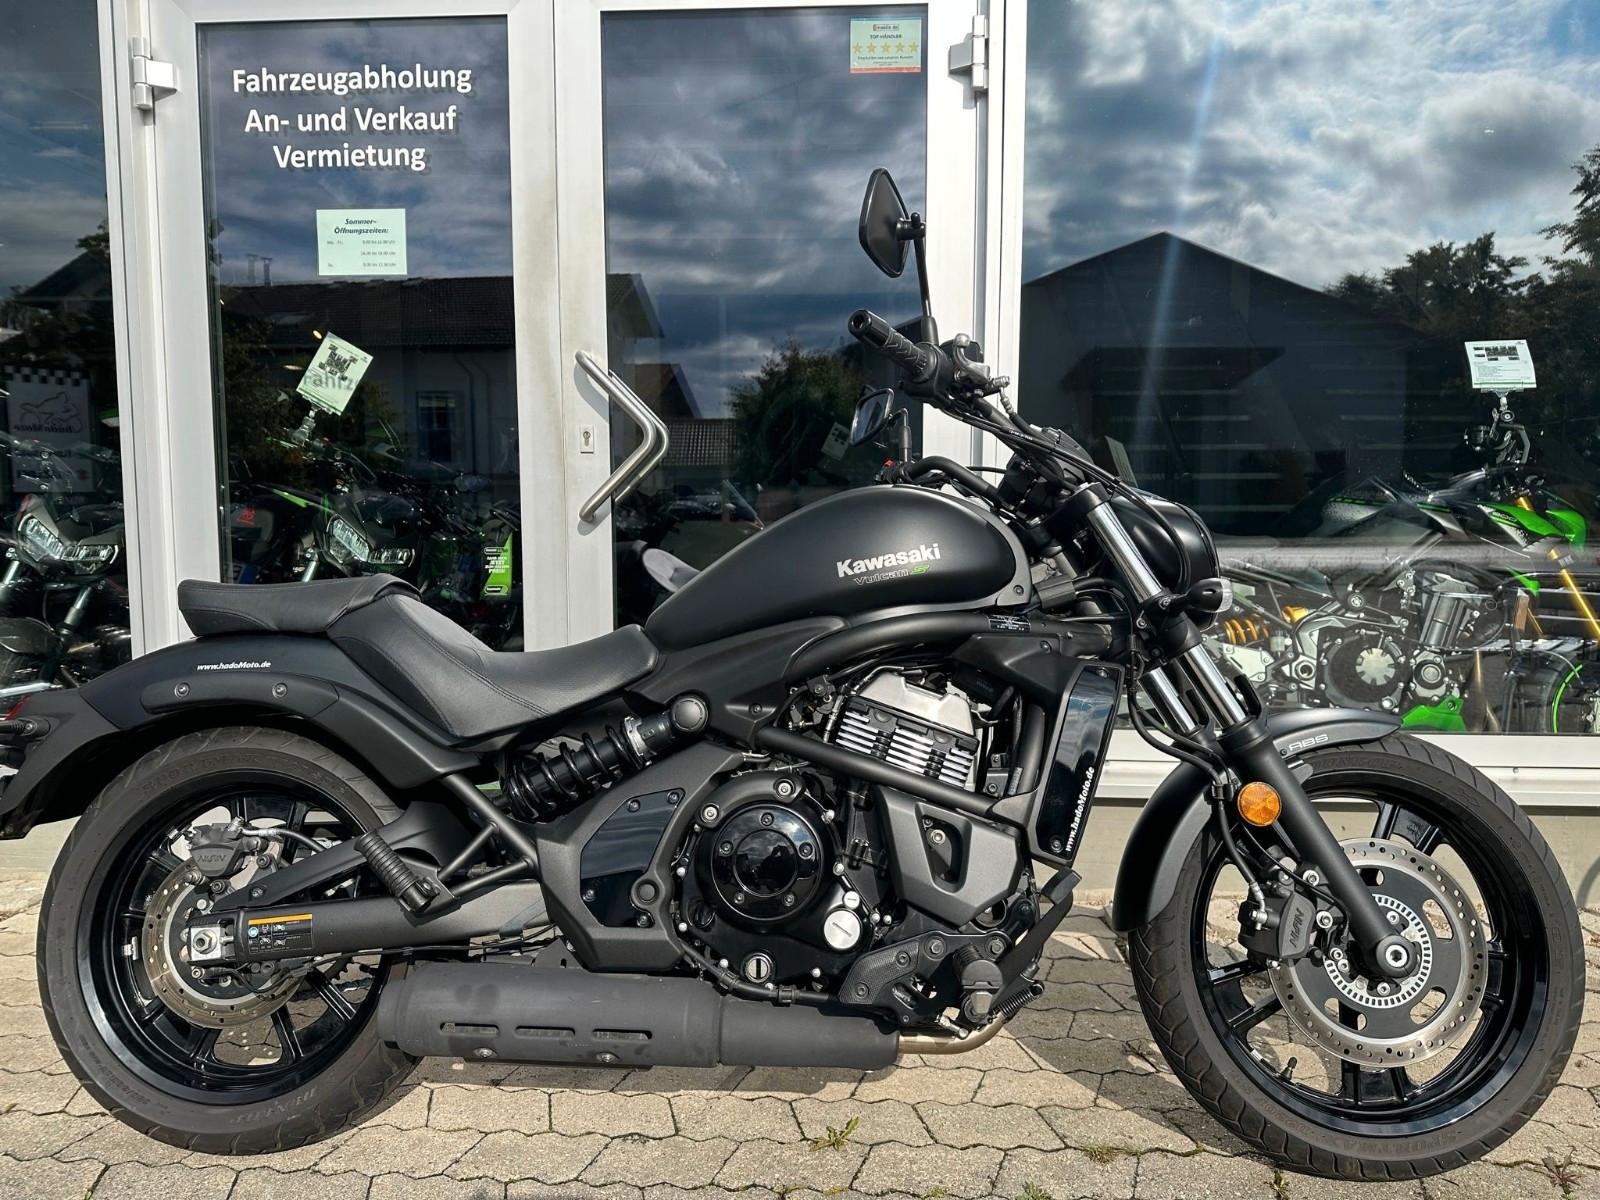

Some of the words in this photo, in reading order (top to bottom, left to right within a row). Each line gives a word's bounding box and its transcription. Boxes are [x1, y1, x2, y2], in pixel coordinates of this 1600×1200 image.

[232, 63, 472, 95] Fahrzeugabholung
[244, 109, 290, 133] An-
[297, 106, 347, 132] und
[353, 105, 457, 131] Verkauf
[273, 143, 426, 171] Vermietung
[836, 543, 941, 578] Kawasaki
[196, 660, 272, 671] www.hadoMoto.de
[1288, 733, 1329, 751] ABS
[1065, 766, 1095, 852] www.hadoMoto.de
